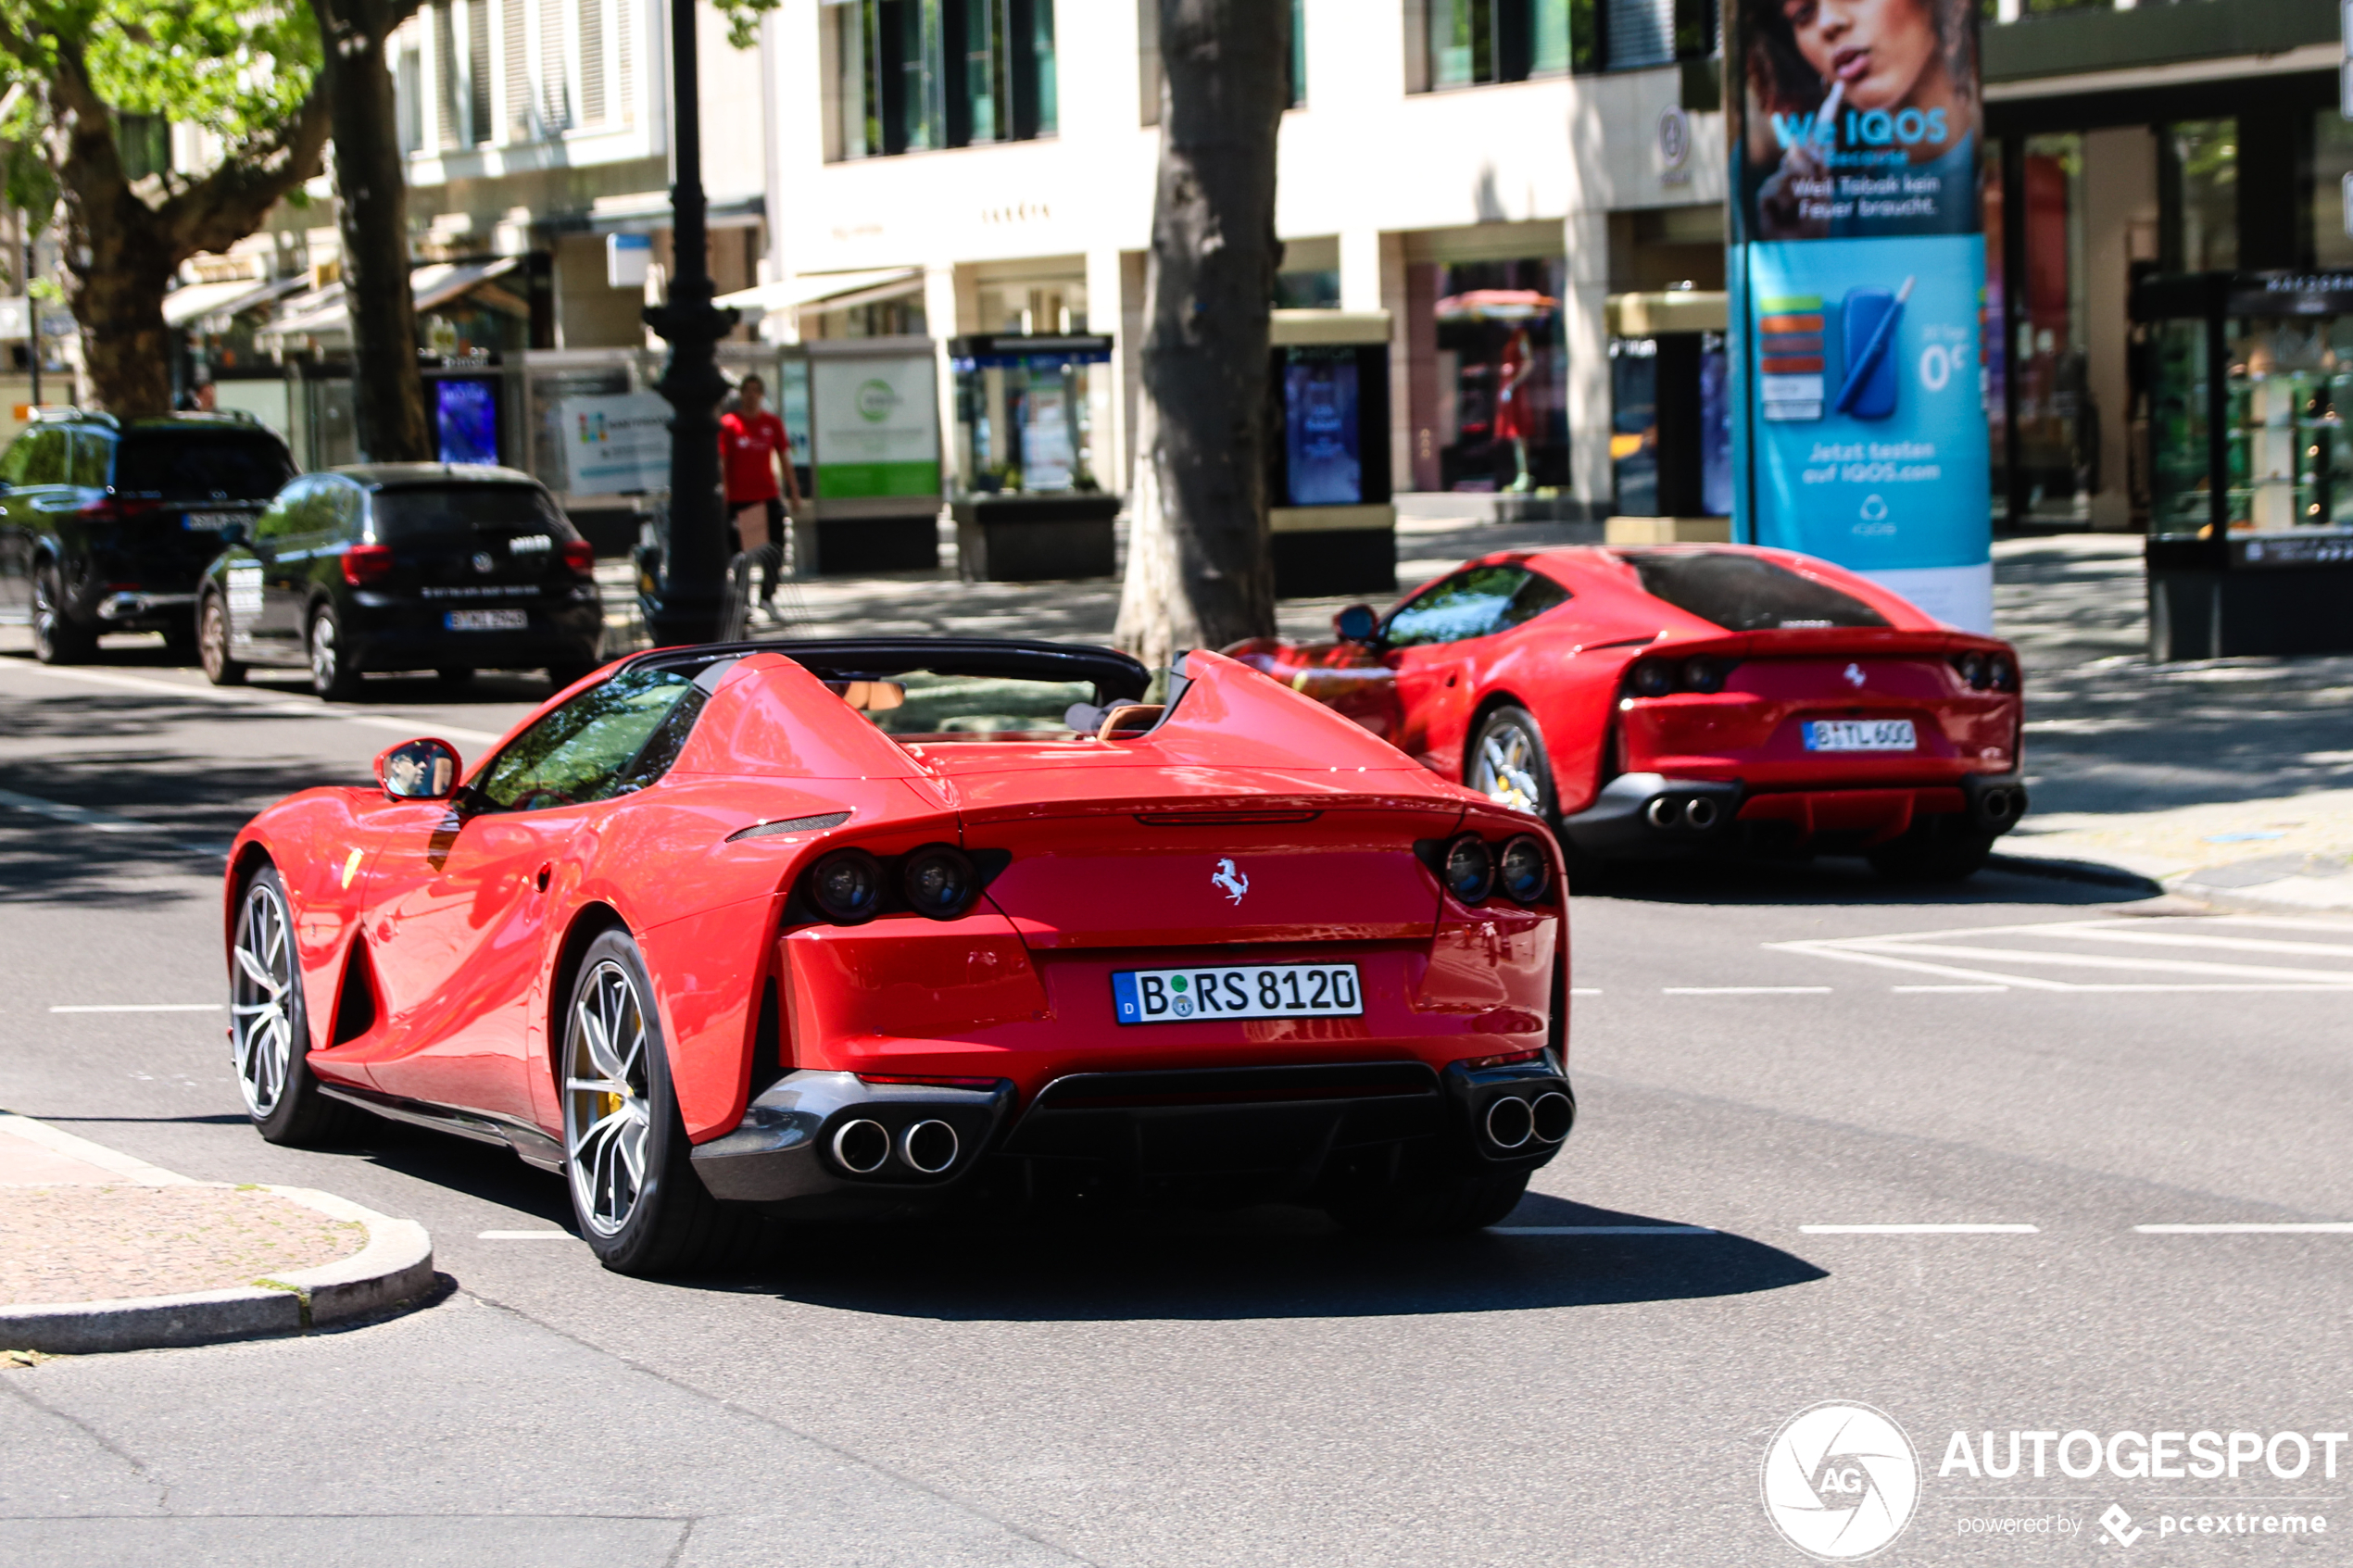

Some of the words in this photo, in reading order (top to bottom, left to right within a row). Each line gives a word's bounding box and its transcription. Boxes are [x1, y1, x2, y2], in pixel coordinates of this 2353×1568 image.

[1771, 112, 1836, 148] We
[1845, 107, 1947, 145] IQOS
[1793, 176, 1833, 196] Weil
[1840, 175, 1898, 194] Tabak
[1904, 175, 1940, 193] kein
[1800, 199, 1852, 219] Feuer
[1858, 197, 1937, 216] braucht.
[1810, 443, 1864, 461] Jetzt
[1869, 442, 1933, 458] testen
[1803, 465, 1836, 483] auf
[1842, 463, 1939, 482] IQOS.com
[1816, 722, 1829, 745] B
[1843, 722, 1869, 744] TL
[1874, 721, 1913, 744] 600
[1124, 1003, 1135, 1014] D
[1141, 975, 1168, 1015] B
[1195, 972, 1248, 1011] RS
[1258, 970, 1355, 1010] 8120
